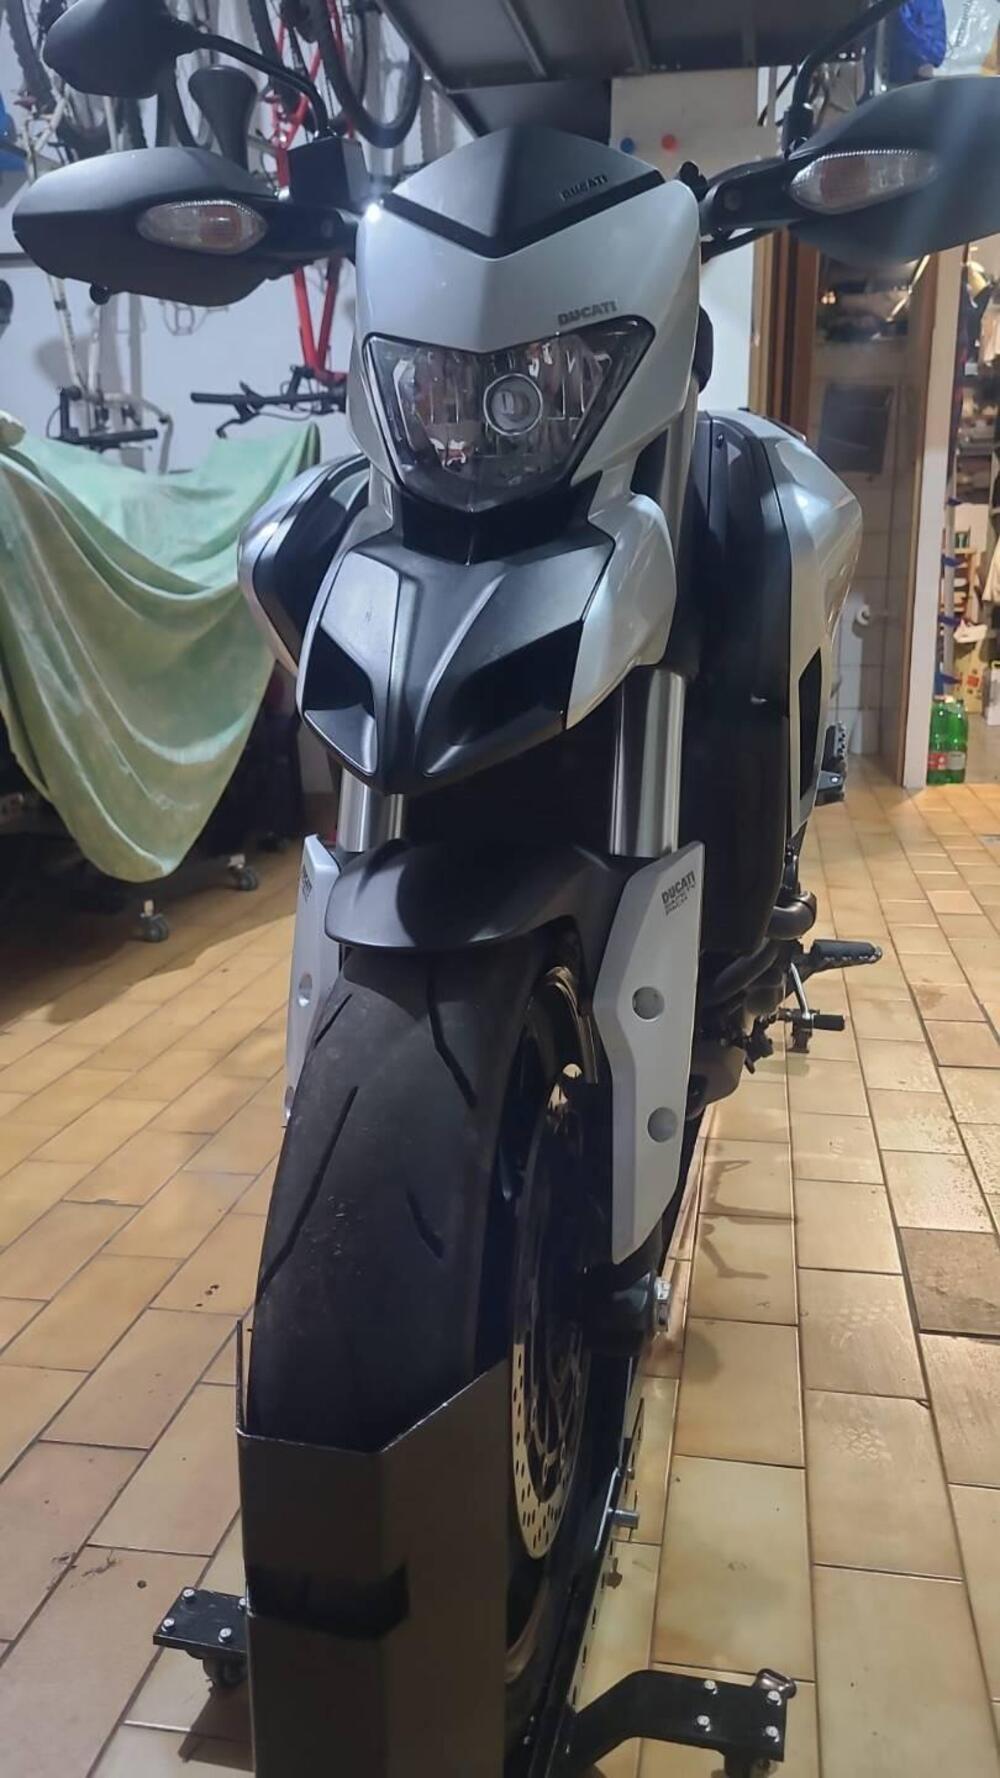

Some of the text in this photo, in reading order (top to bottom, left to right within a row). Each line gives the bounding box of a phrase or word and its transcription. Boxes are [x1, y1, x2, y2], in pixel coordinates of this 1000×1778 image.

[559, 174, 608, 201] DUCATI
[558, 300, 617, 326] DUCATI
[661, 870, 695, 904] DUCATI
